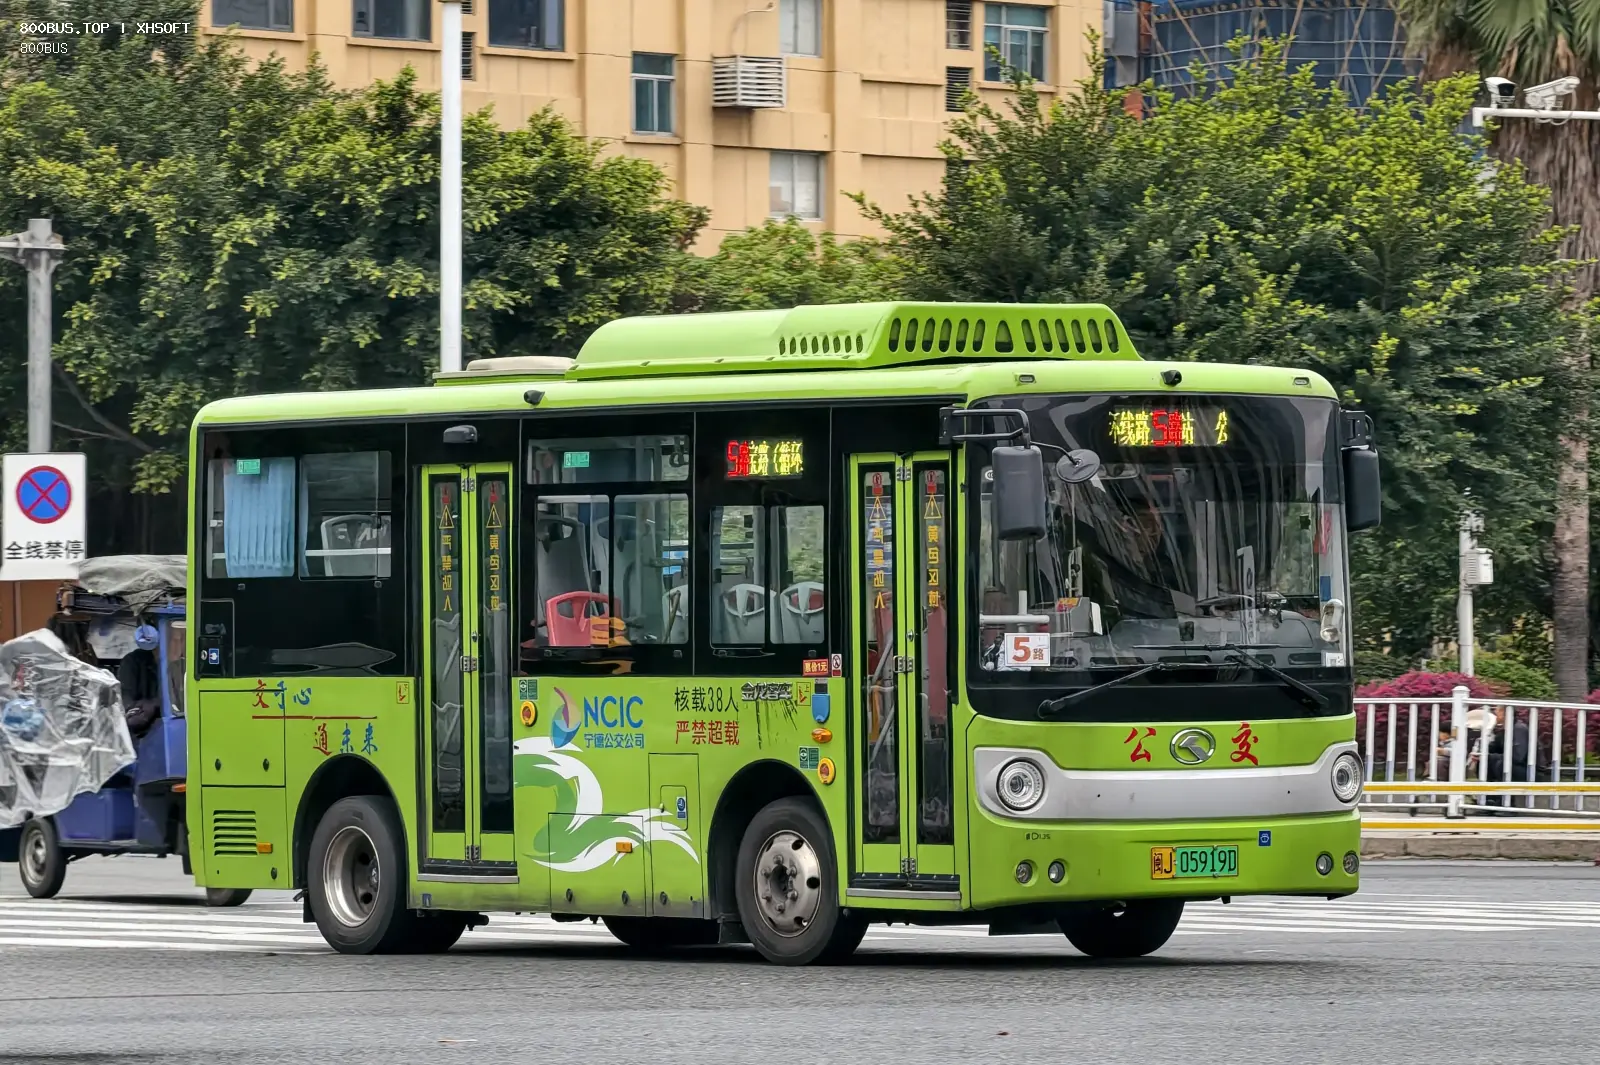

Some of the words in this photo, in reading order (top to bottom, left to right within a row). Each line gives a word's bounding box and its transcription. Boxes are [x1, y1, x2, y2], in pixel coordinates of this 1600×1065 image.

[4, 540, 85, 560] 全线禁停
[1012, 636, 1044, 662] 5路
[583, 695, 644, 729] NCIC
[674, 686, 739, 713] 核载38人
[675, 719, 740, 746] 严禁超载
[1124, 727, 1157, 762] 公
[1230, 721, 1259, 766] 交
